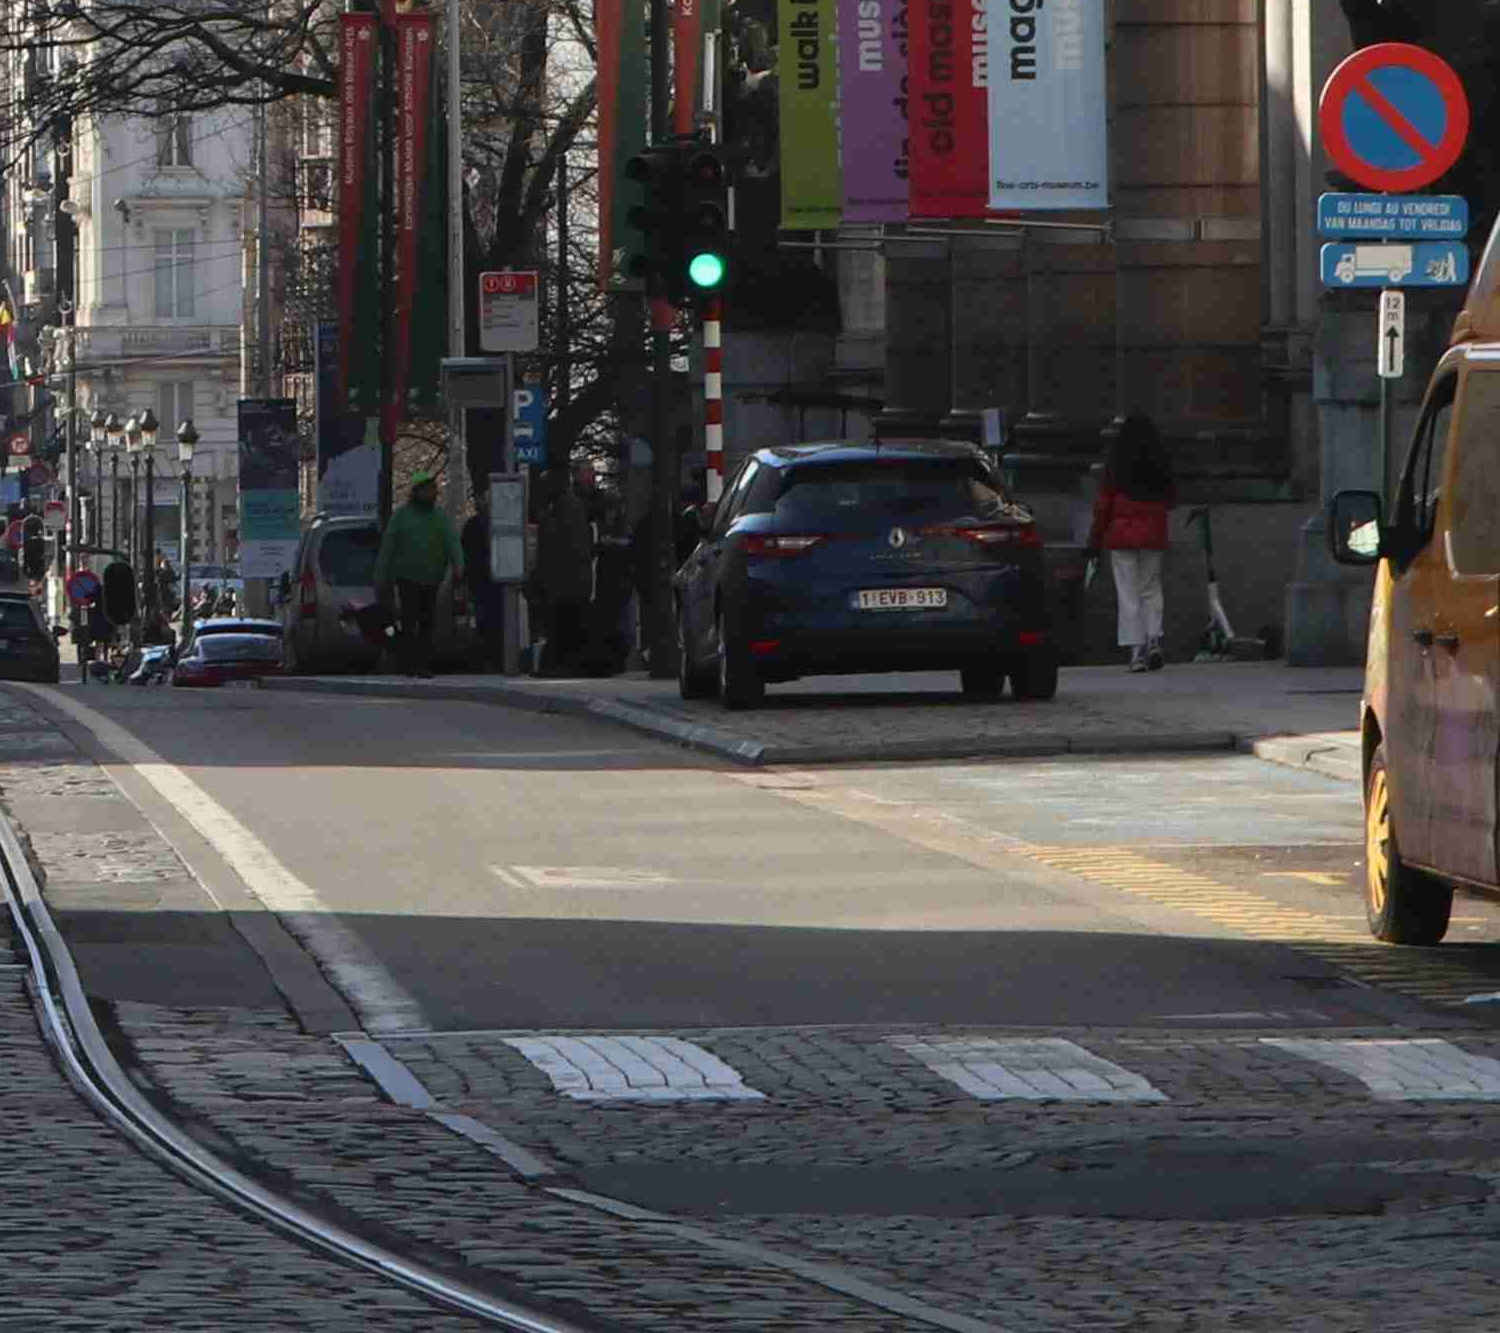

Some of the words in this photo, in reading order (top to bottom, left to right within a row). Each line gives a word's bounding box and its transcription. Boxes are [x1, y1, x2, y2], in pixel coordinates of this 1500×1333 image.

[790, 11, 820, 90] walk
[924, 93, 956, 155] old
[1399, 217, 1417, 230] TOT
[1387, 297, 1400, 310] 12
[514, 389, 534, 420] P
[515, 445, 540, 459] AXI
[862, 591, 945, 606] 1-EVB-913
